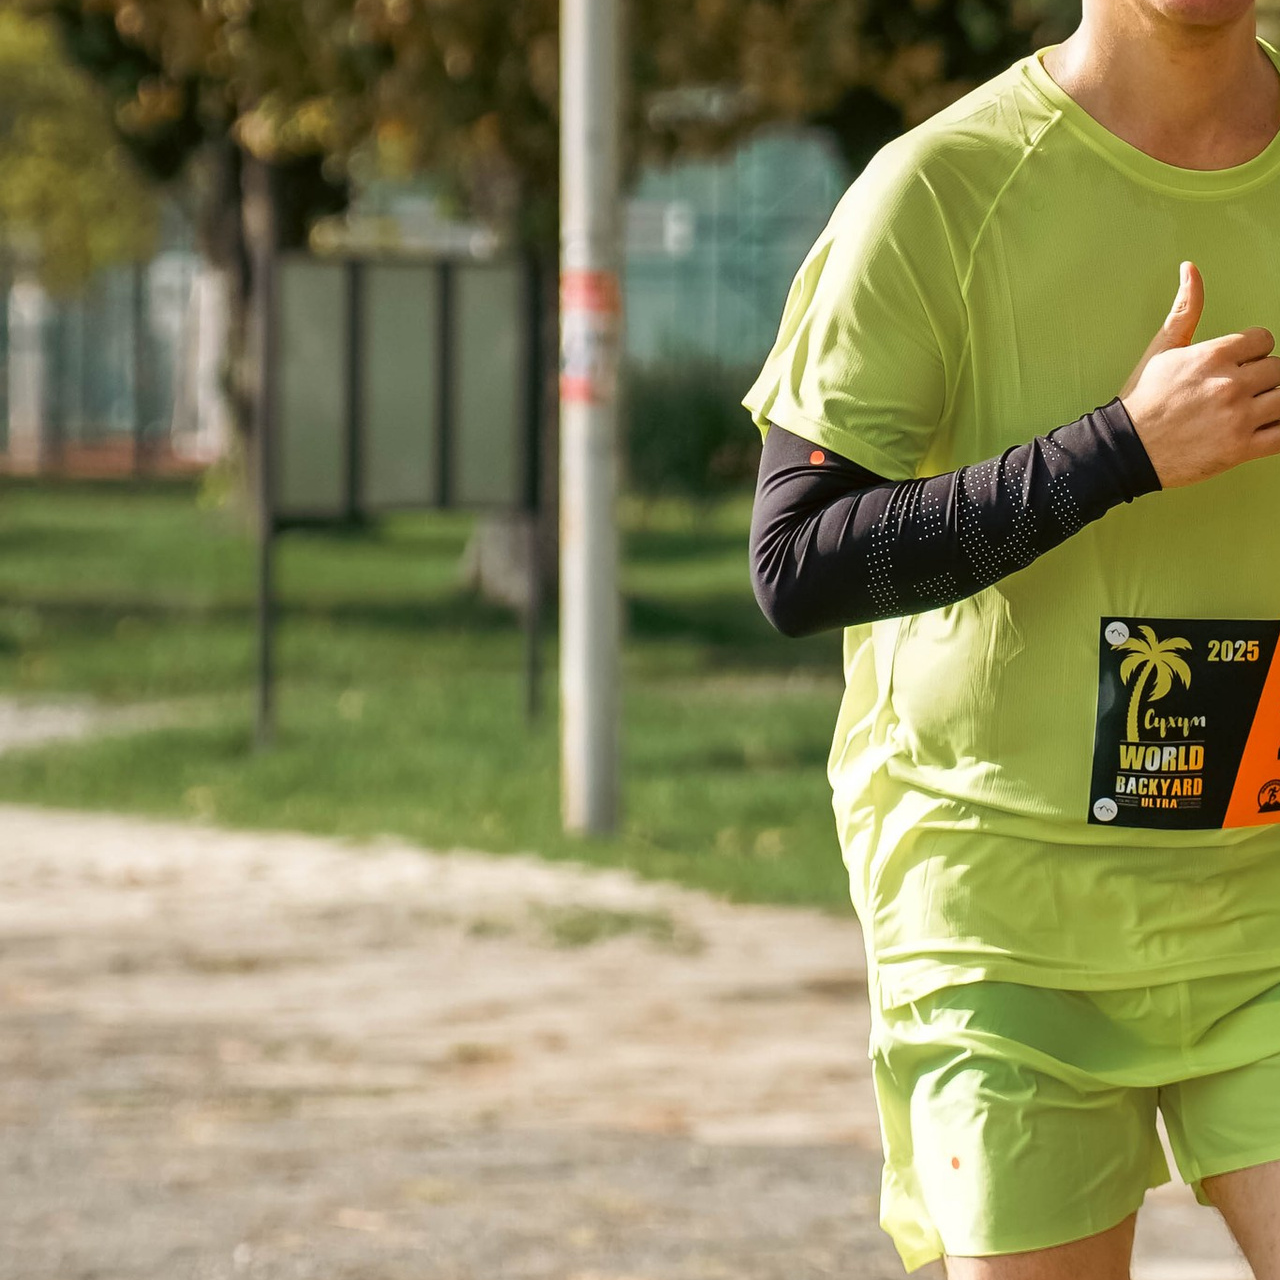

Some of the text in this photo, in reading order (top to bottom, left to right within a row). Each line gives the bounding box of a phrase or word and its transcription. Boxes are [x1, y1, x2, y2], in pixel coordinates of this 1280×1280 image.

[1207, 640, 1259, 662] 2025
[1119, 745, 1204, 772] WORLD
[1115, 776, 1203, 796] BACKYARD
[1141, 797, 1178, 809] ULTRA
